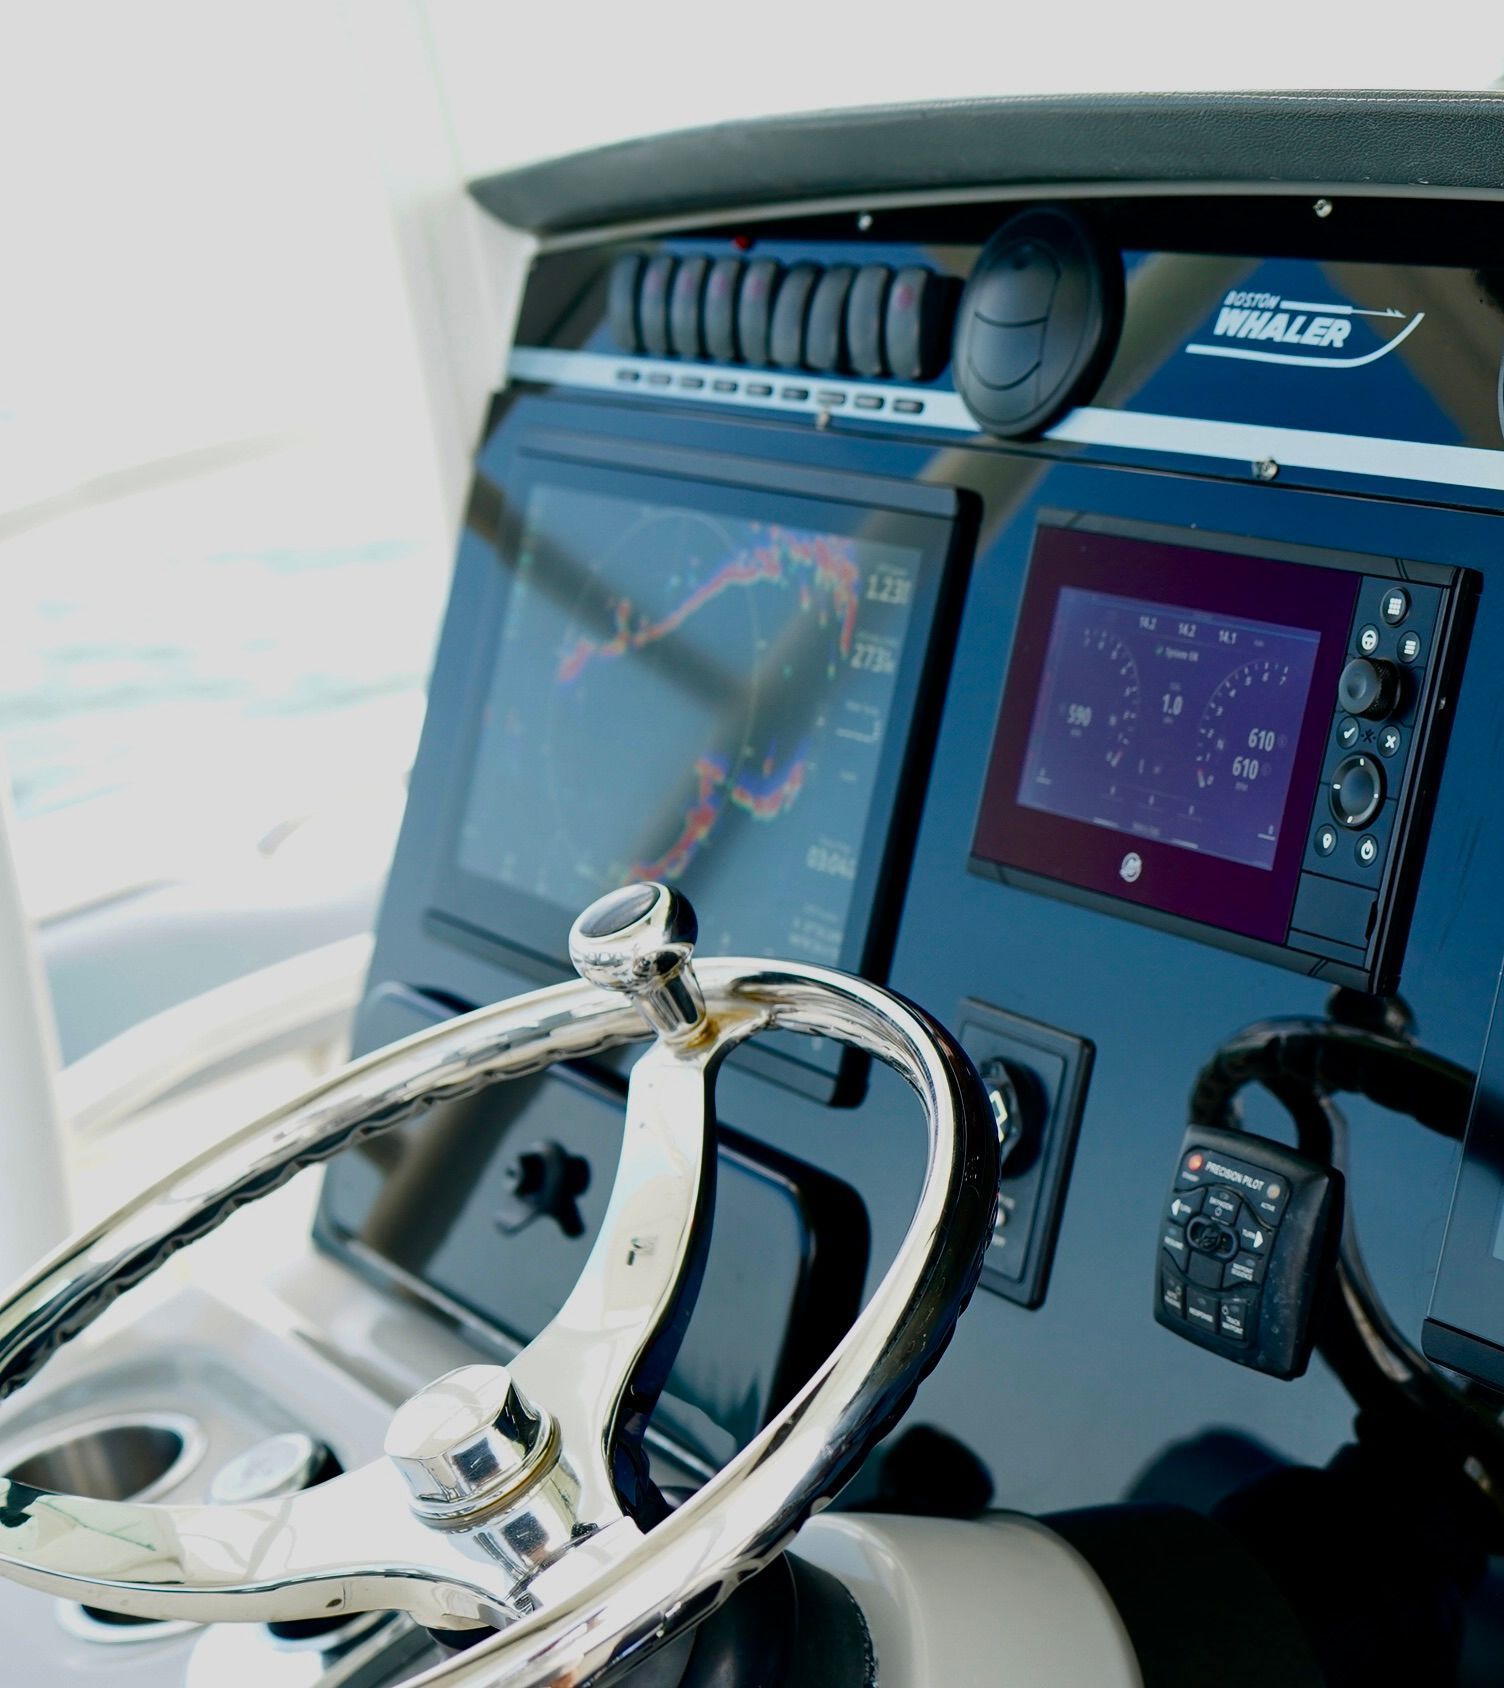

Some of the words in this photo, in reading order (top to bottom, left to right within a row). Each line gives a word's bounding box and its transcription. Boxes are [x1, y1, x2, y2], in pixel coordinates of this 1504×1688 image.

[1224, 290, 1280, 310] BOSTON
[1213, 307, 1352, 348] WHALER
[1218, 629, 1237, 645] 14.1
[1162, 693, 1183, 716] 1.0
[1248, 727, 1276, 752] 610
[1232, 755, 1260, 781] 610
[1242, 1174, 1265, 1191] PILOT
